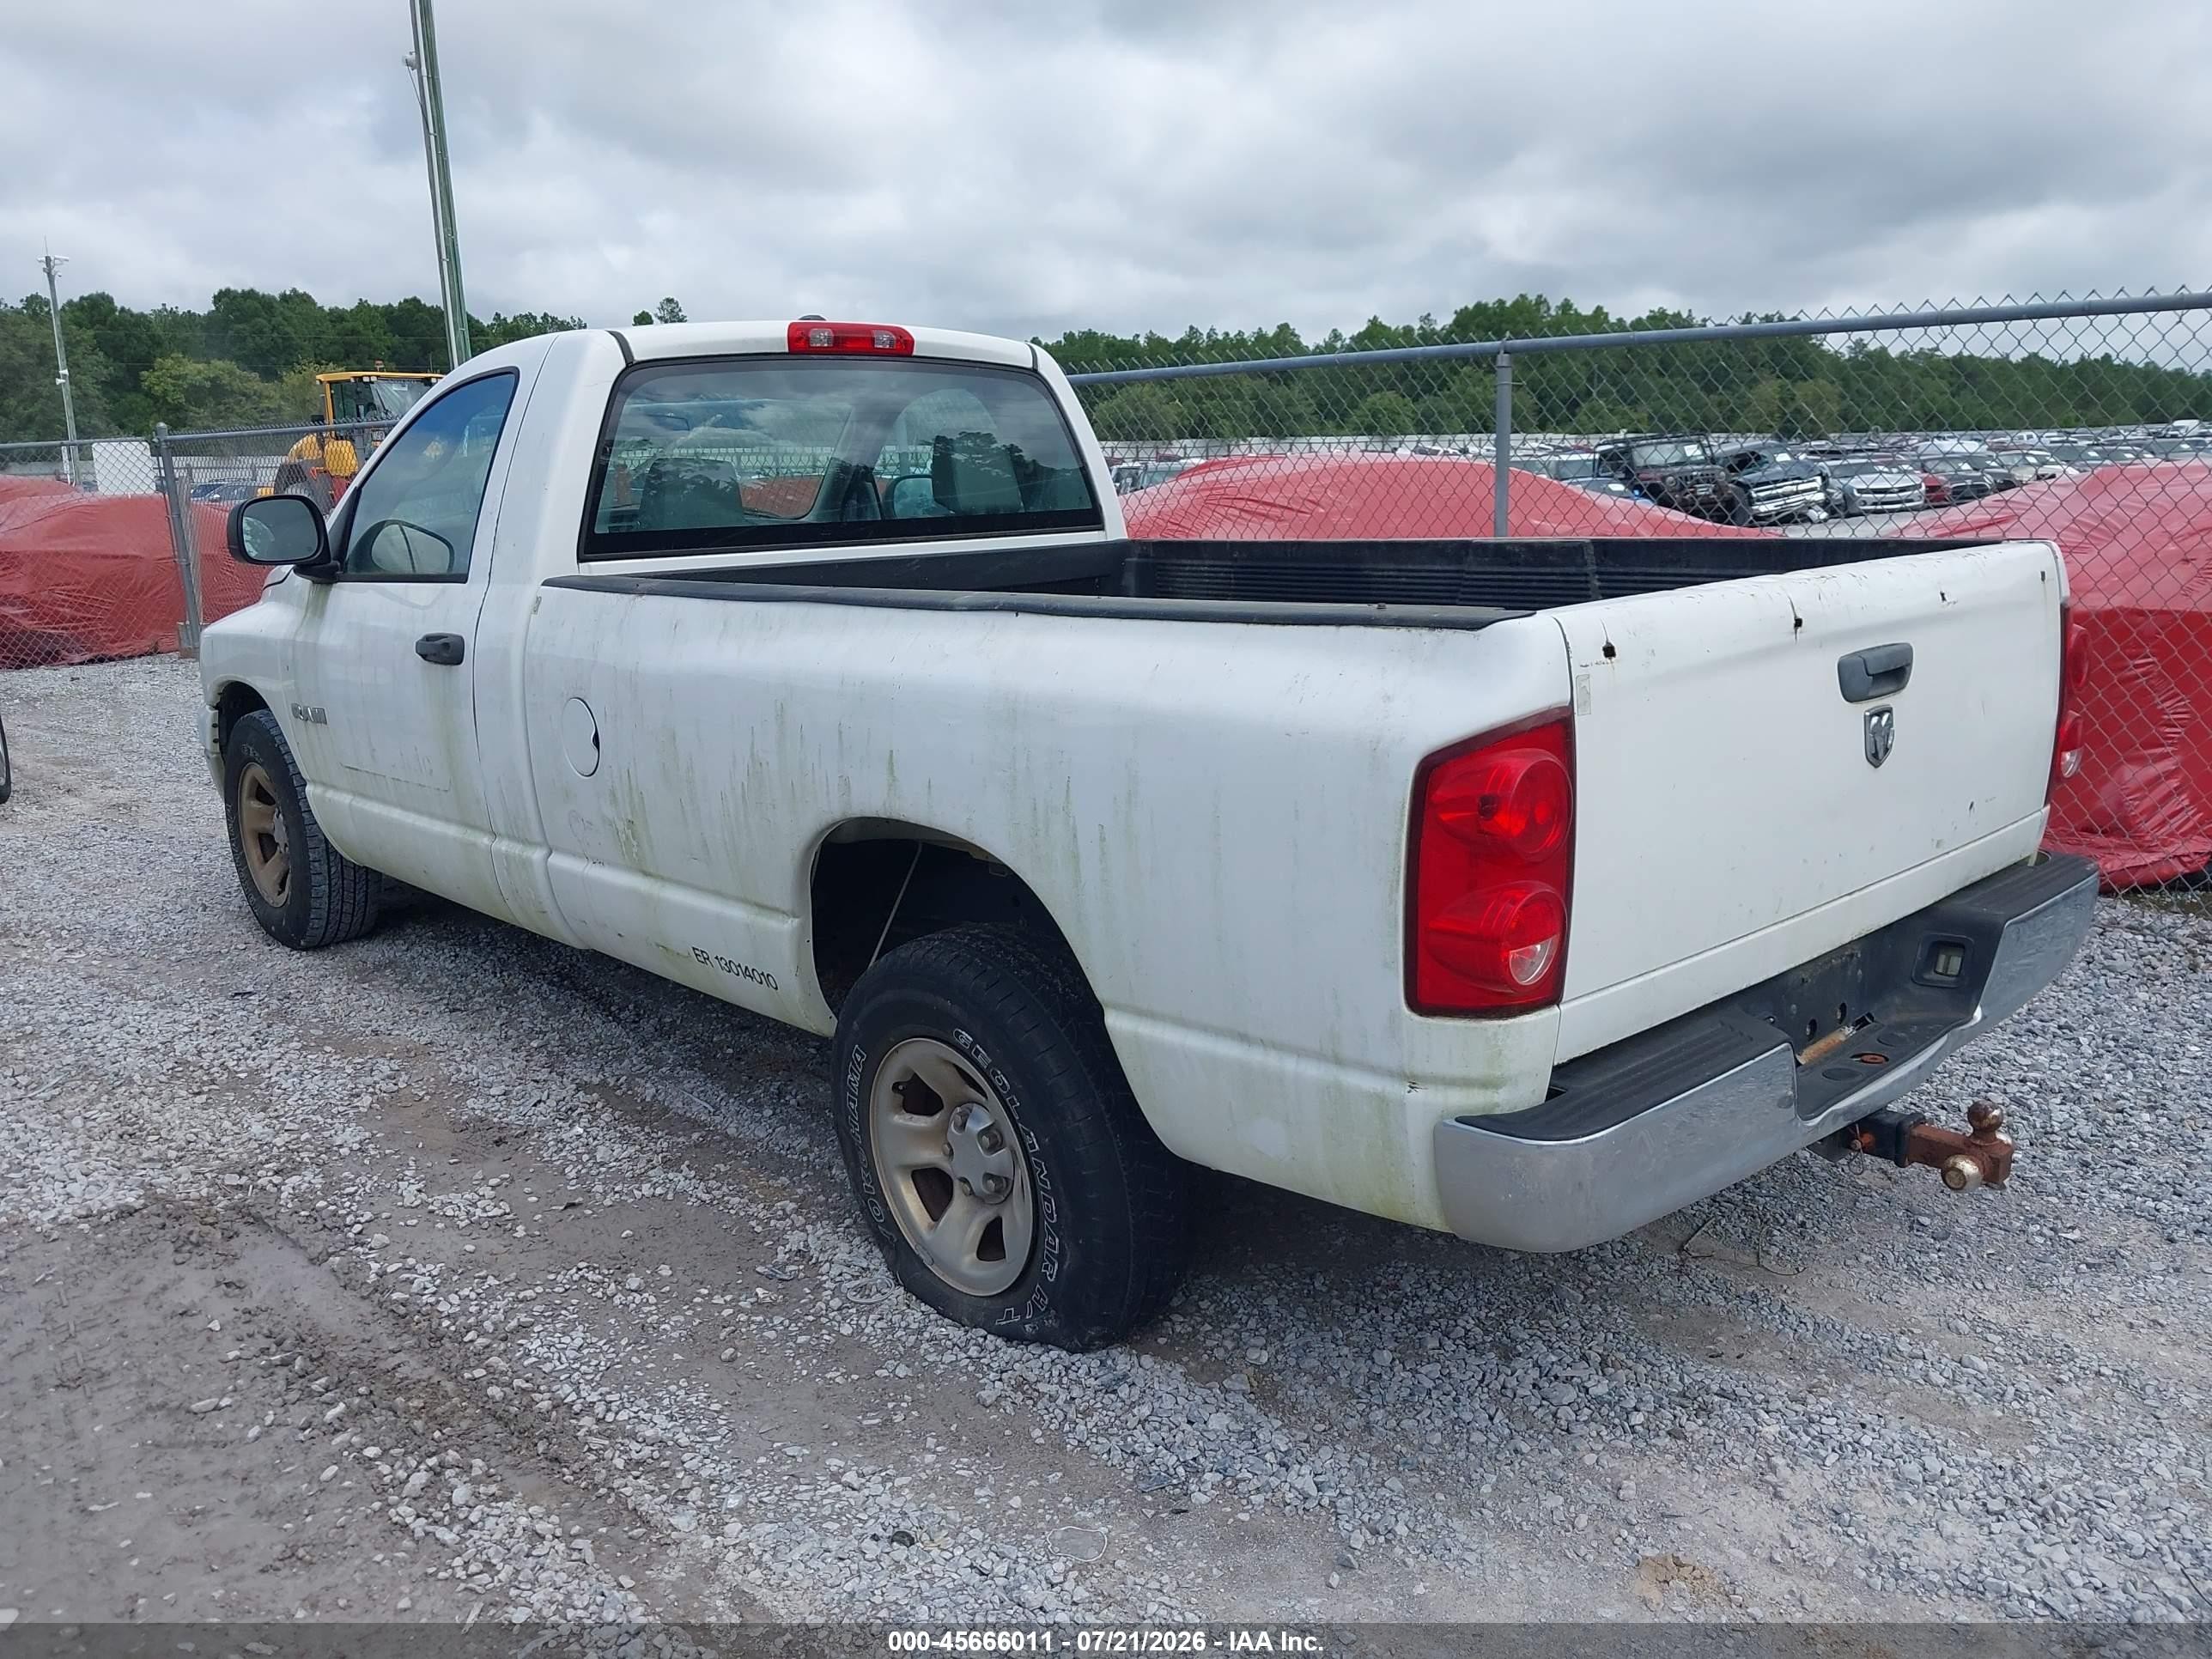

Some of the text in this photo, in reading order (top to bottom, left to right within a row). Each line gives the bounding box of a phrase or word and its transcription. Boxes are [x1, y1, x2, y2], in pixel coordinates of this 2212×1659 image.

[691, 946, 778, 990] ER 13014010
[952, 1028, 1060, 1282] GEOLANDAR
